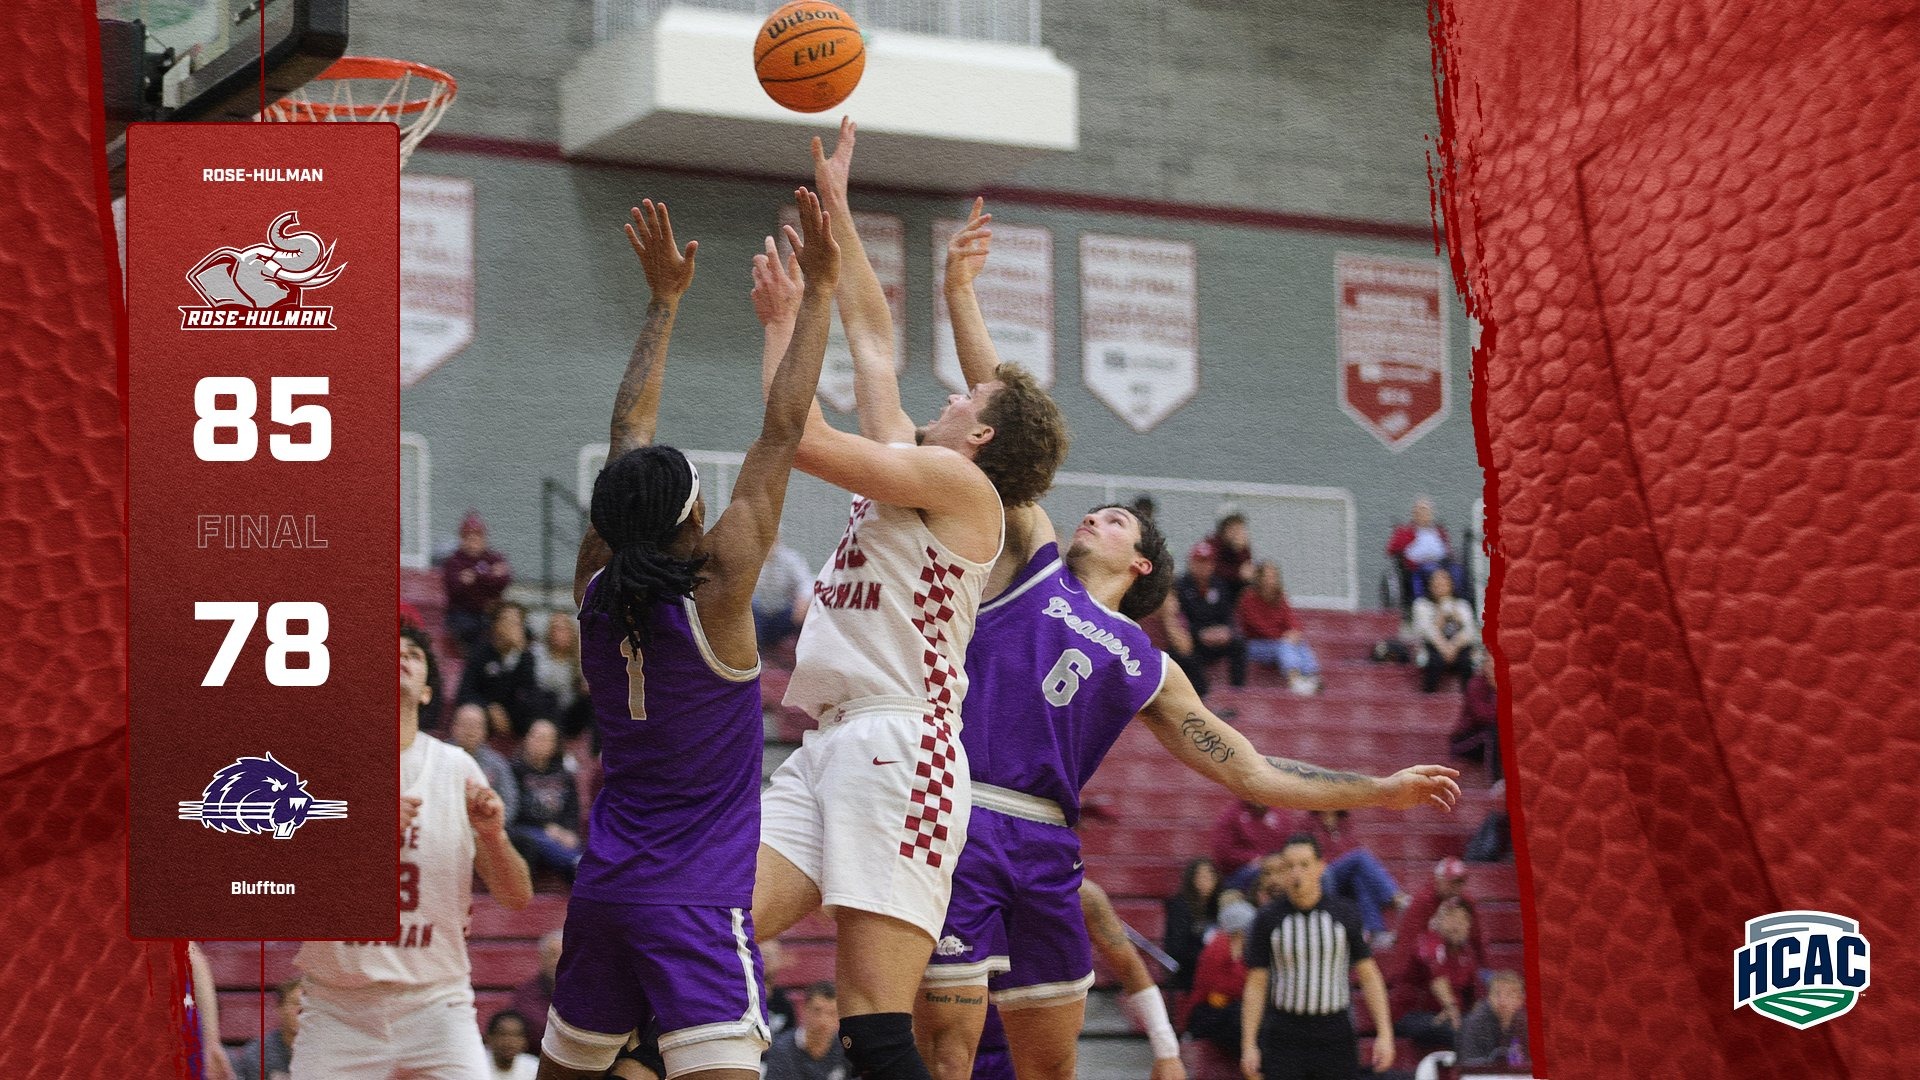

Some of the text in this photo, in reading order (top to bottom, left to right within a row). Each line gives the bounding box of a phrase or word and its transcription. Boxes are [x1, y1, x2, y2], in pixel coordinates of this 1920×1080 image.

[767, 9, 840, 39] Wilson
[1042, 597, 1142, 677] Beavers
[620, 630, 647, 720] 1
[1042, 648, 1093, 708] 6
